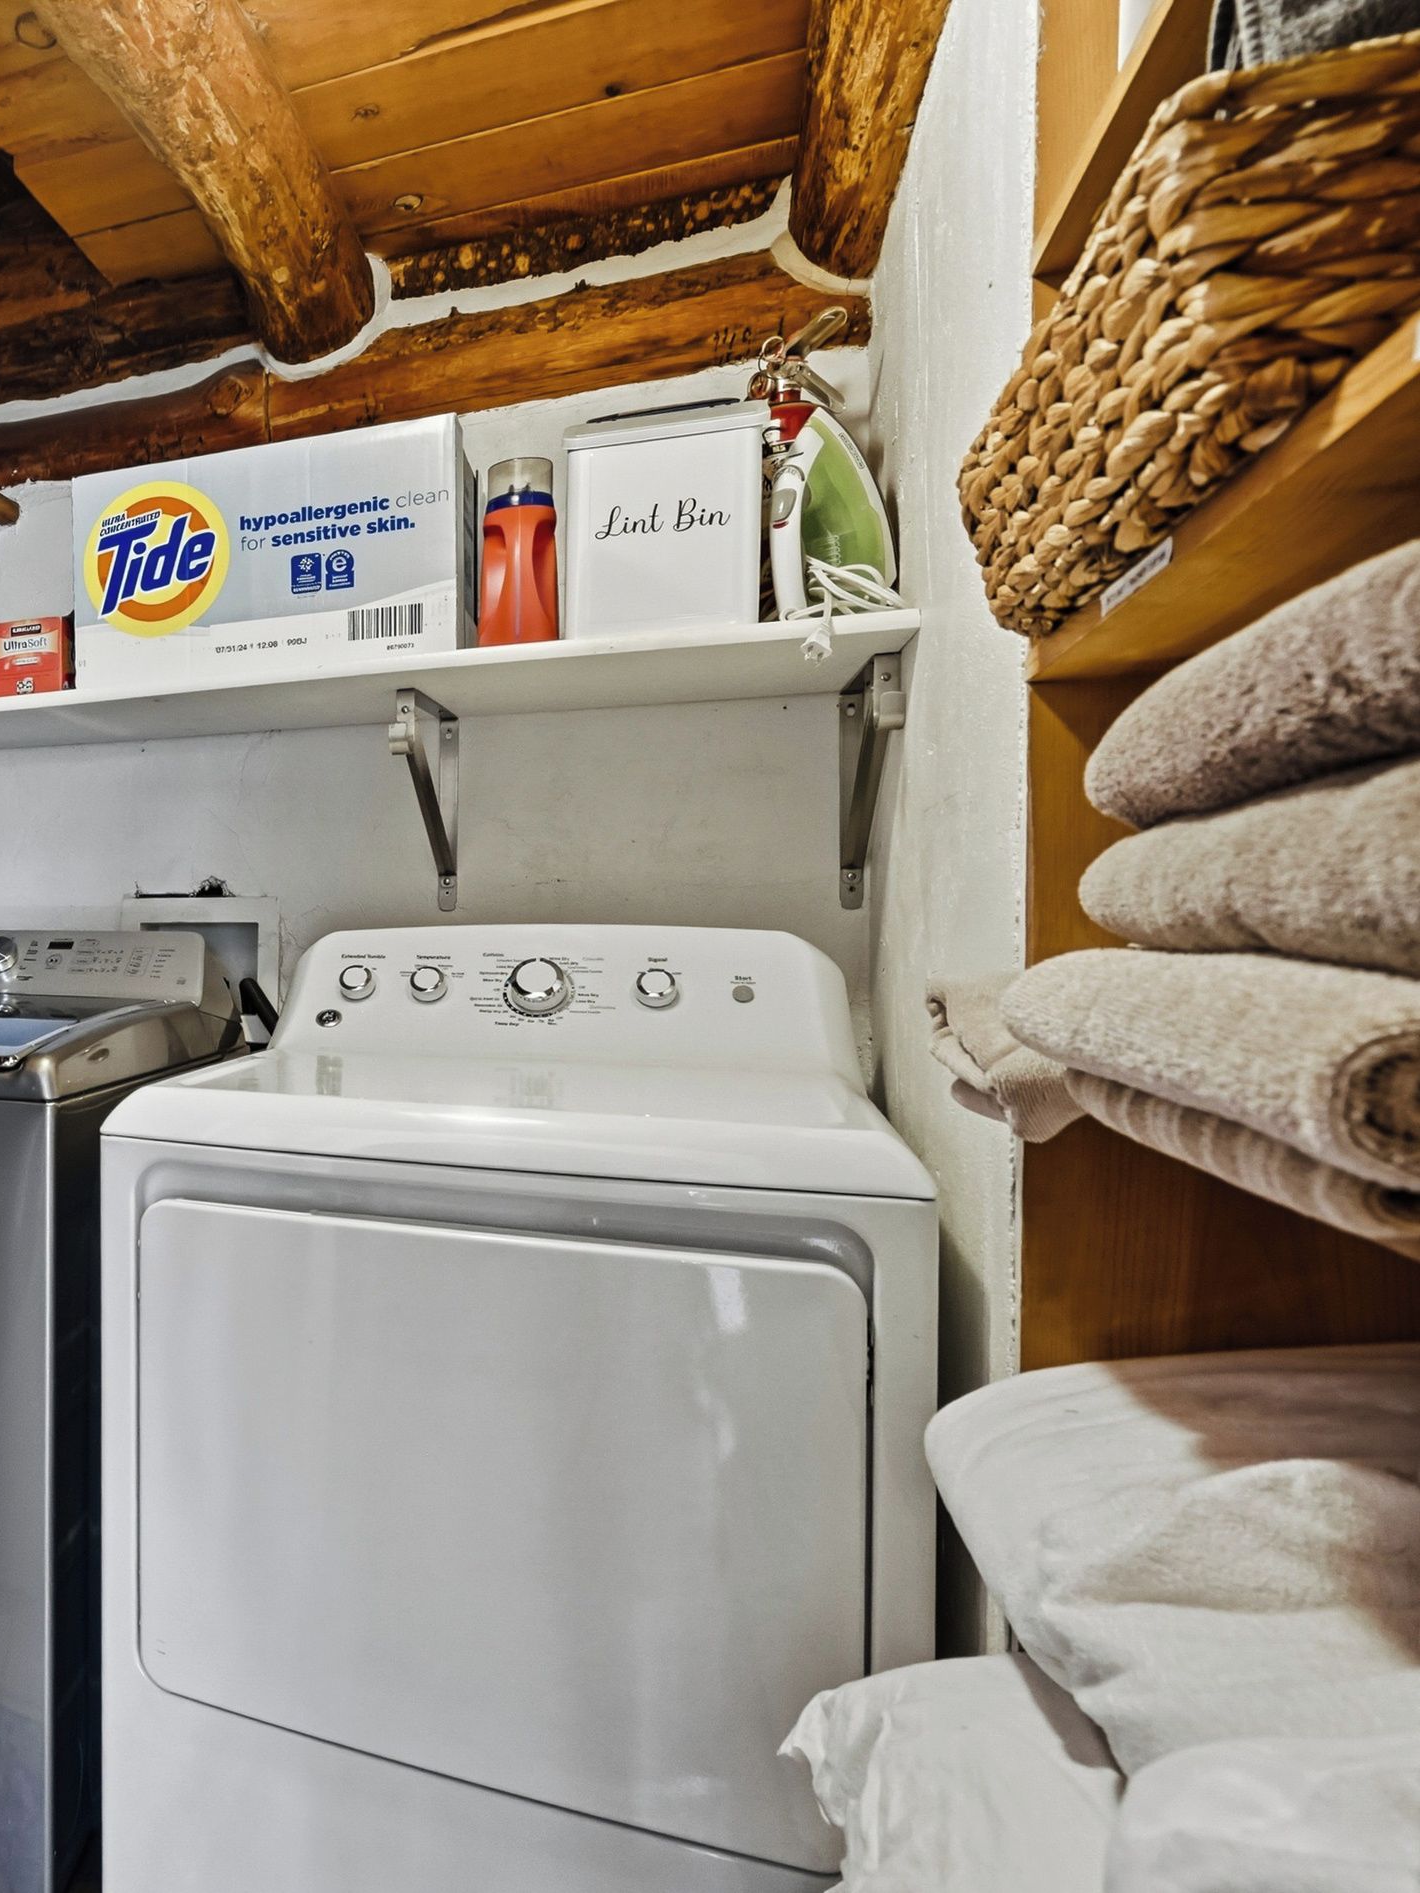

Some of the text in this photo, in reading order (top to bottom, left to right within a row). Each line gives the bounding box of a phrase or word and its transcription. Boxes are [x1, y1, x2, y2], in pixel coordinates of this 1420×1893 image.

[239, 489, 450, 532] hypoallergenic clean
[594, 497, 731, 540] Lint Bin
[241, 515, 416, 551] for sensitive skin.
[97, 515, 216, 616] Tide
[3, 637, 47, 651] UltraSoft
